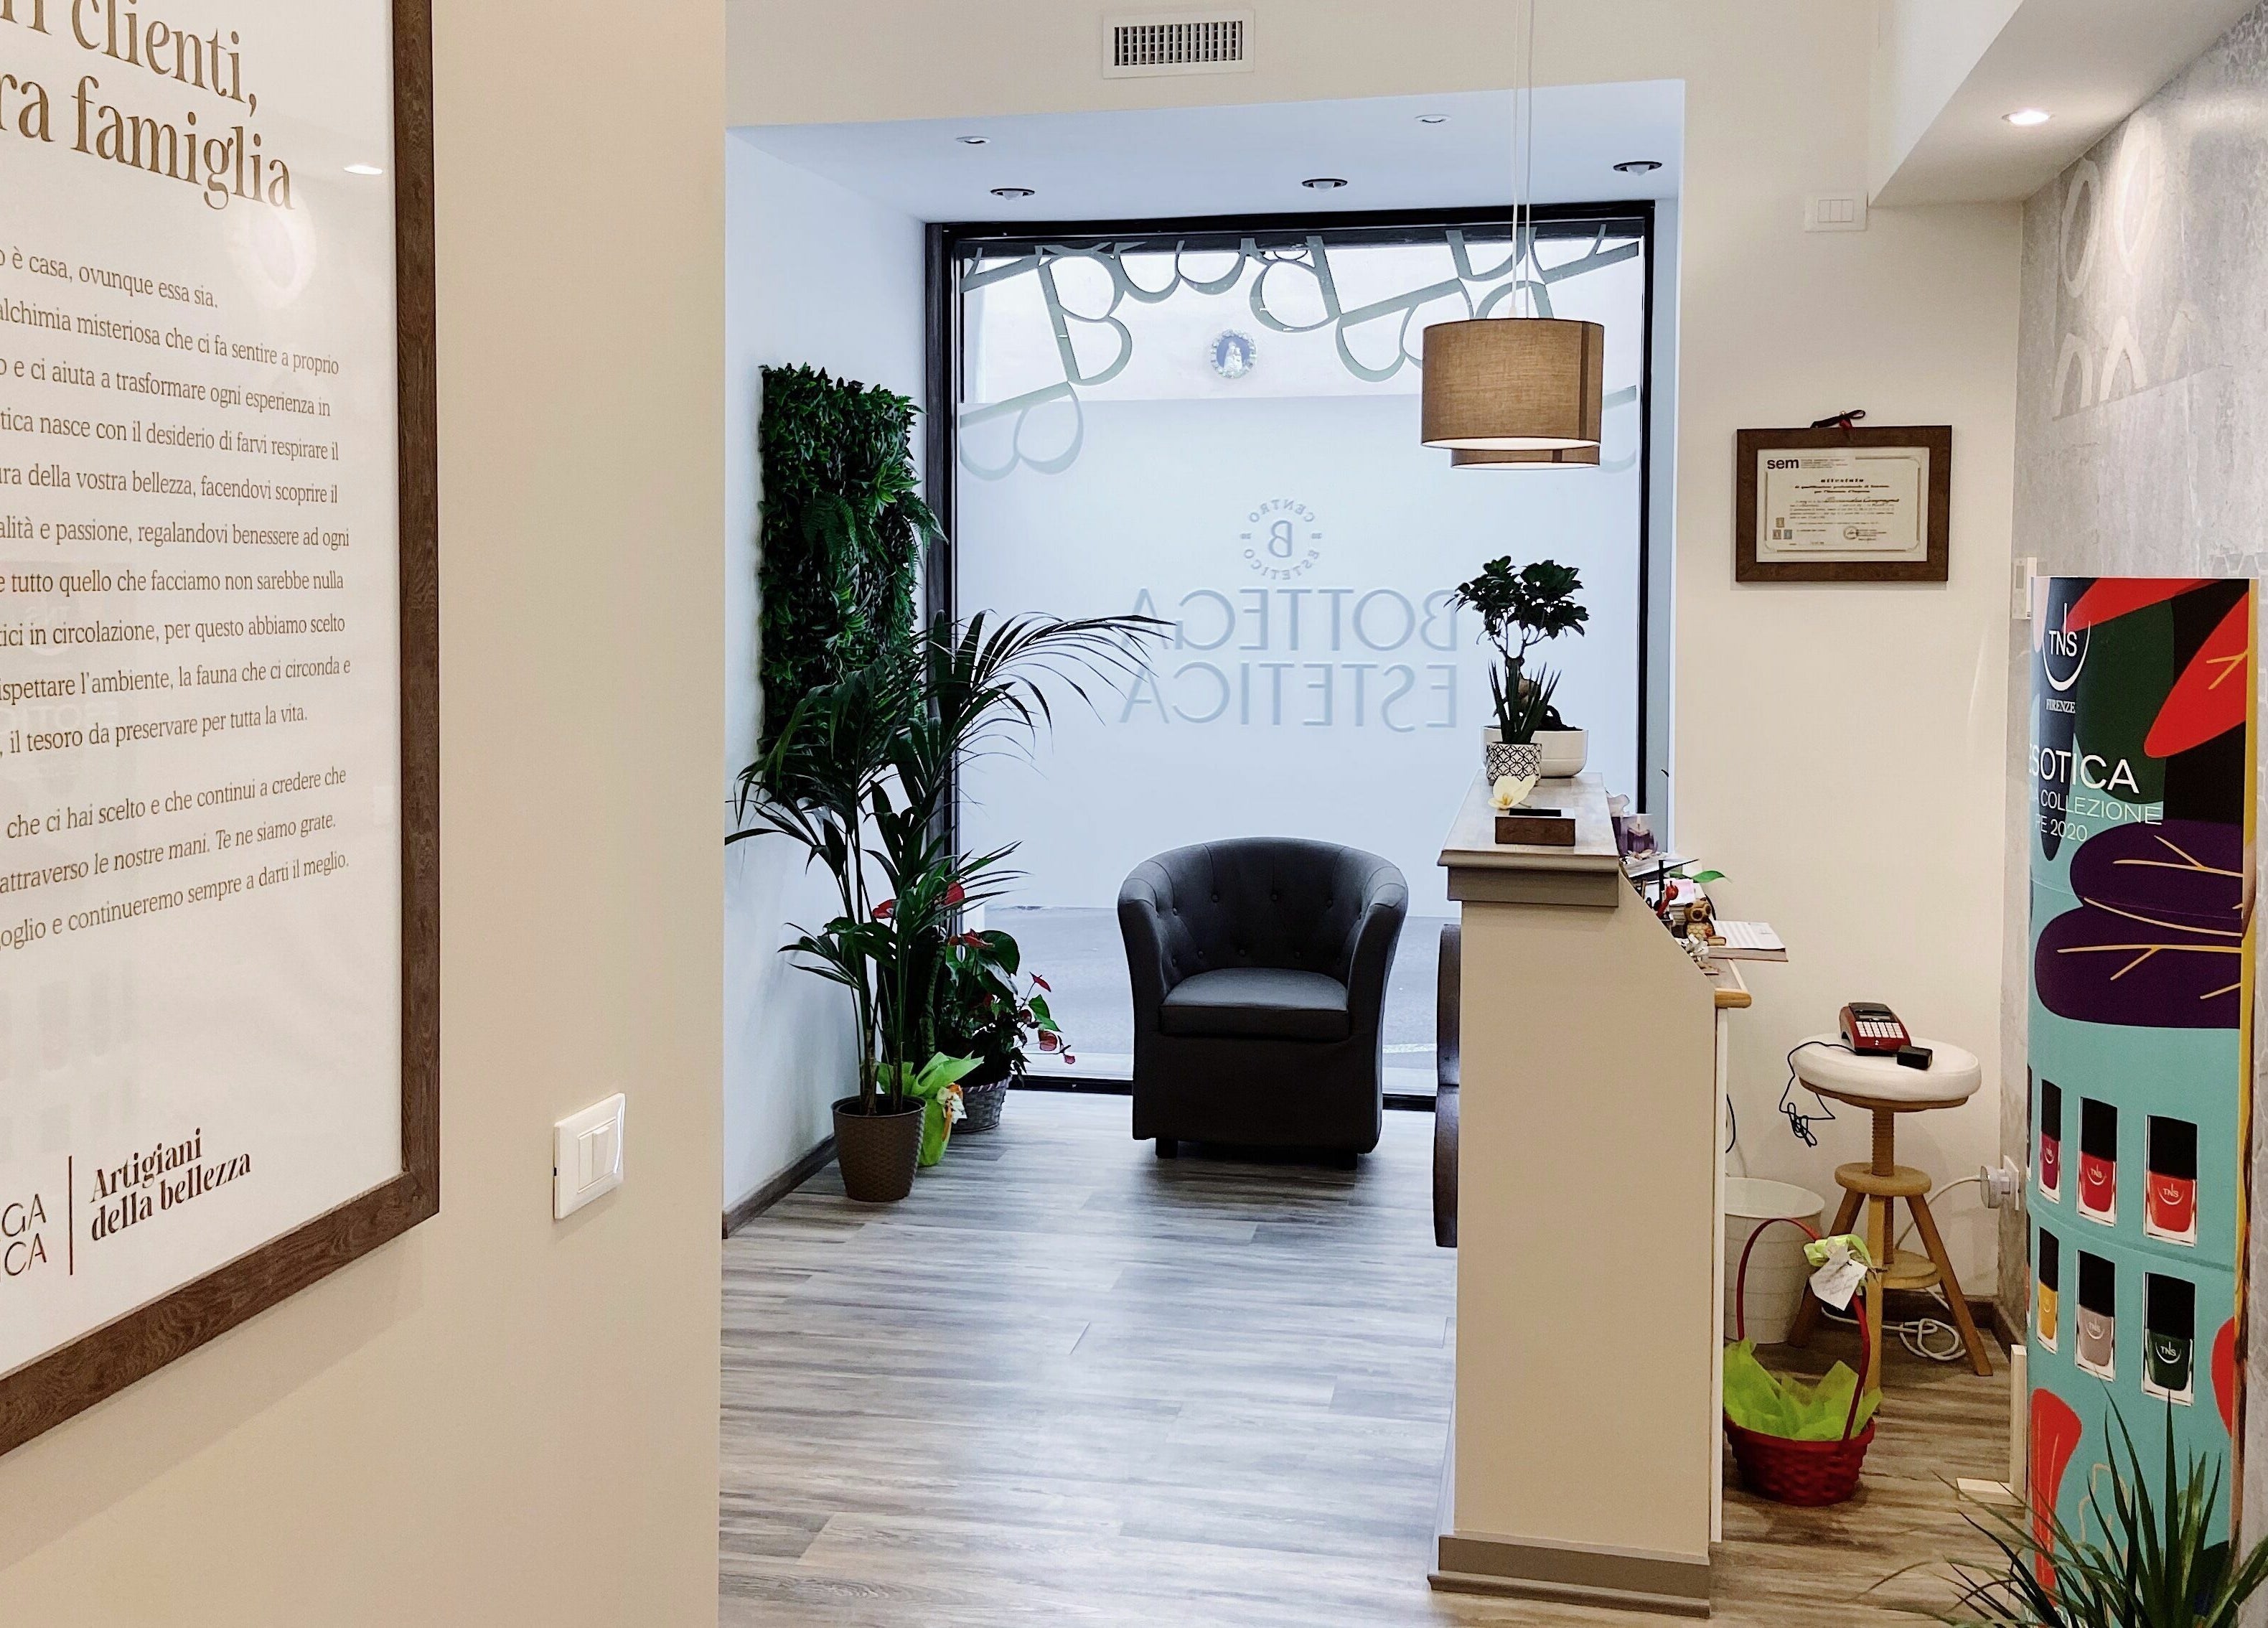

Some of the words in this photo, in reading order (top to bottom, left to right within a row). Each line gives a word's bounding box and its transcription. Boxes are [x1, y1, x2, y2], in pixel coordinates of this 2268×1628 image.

[70, 0, 257, 116] clienti,
[70, 75, 294, 210] famiglia
[12, 245, 23, 269] è
[29, 256, 72, 283] casa,
[79, 266, 154, 297] ovunque
[159, 282, 189, 302] essa
[195, 285, 217, 308] sia.
[76, 314, 161, 346] misteriosa
[165, 327, 193, 350] che
[198, 333, 210, 354] ci
[214, 335, 228, 357] fa
[232, 342, 277, 364] sentire
[281, 352, 289, 366] a
[293, 354, 339, 376] proprio
[14, 361, 24, 378] e
[31, 357, 45, 380] ci
[52, 360, 95, 387] aiuta
[101, 373, 111, 388] a
[116, 372, 206, 401] trasformare
[210, 385, 241, 408] ogni
[245, 391, 315, 415] esperienza
[318, 397, 330, 416] in
[37, 417, 90, 437] nasce
[96, 423, 127, 441] con
[132, 420, 141, 442] il
[146, 422, 215, 449] desiderio
[219, 430, 233, 451] di
[237, 431, 267, 454] farvi
[271, 438, 328, 462] respirare
[331, 441, 339, 461] il
[1767, 458, 1799, 469] sem
[28, 463, 71, 488] della
[75, 472, 127, 491] vostra
[132, 470, 196, 498] bellezza,
[200, 475, 271, 500] facendovi
[276, 483, 327, 506] scoprire
[329, 485, 337, 503] il
[40, 523, 50, 539] e
[55, 518, 131, 546] passione,
[138, 521, 228, 547] regalandovi
[232, 523, 299, 546] benessere
[303, 526, 319, 546] ad
[322, 528, 349, 551] ogni
[11, 573, 53, 592] tutto
[59, 569, 111, 597] quello
[117, 569, 146, 591] che
[151, 569, 220, 591] facciamo
[225, 575, 253, 590] non
[256, 570, 309, 591] sarebbe
[313, 569, 343, 589] nulla
[28, 622, 47, 645] in
[52, 619, 159, 644] circolazione,
[164, 624, 190, 645] per
[195, 620, 243, 643] questo
[247, 614, 306, 635] abbiamo
[310, 613, 345, 633] scelto
[179, 666, 192, 686] la
[197, 665, 237, 686] fauna
[242, 661, 267, 682] che
[270, 660, 281, 679] ci
[286, 655, 339, 678] circonda
[344, 660, 350, 673] e
[10, 729, 21, 754] il
[27, 731, 83, 752] tesoro
[89, 722, 110, 744] da
[114, 719, 197, 747] preservare
[202, 716, 226, 737] per
[230, 711, 261, 729] tutta
[266, 705, 276, 725] la
[281, 703, 307, 722] vita.
[2046, 698, 2076, 714] FIRENZE
[6, 814, 40, 838] che
[45, 808, 60, 832] ci
[66, 804, 93, 829] hai
[98, 798, 146, 824] scelto
[151, 799, 160, 815] e
[165, 790, 192, 812] che
[197, 779, 255, 807] continui
[260, 782, 268, 797] a
[272, 771, 322, 795] credere
[324, 766, 346, 785] che
[2040, 789, 2162, 825] COLLEZIONE
[93, 853, 109, 875] le
[113, 847, 164, 871] nostre
[168, 833, 210, 860] mani.
[215, 829, 231, 850] Te
[235, 830, 253, 846] ne
[256, 821, 296, 843] siamo
[300, 814, 335, 838] grate.
[2051, 818, 2088, 842] 2020
[52, 918, 62, 935] e
[67, 891, 183, 930] continueremo
[187, 878, 242, 903] sempre
[246, 874, 254, 889] a
[258, 861, 289, 886] darti
[293, 859, 299, 879] il
[304, 851, 349, 876] meglio.
[90, 1128, 202, 1203] Artigiani
[91, 1189, 153, 1241] della
[161, 1153, 250, 1211] bellezza
[4, 1232, 47, 1276] CA
